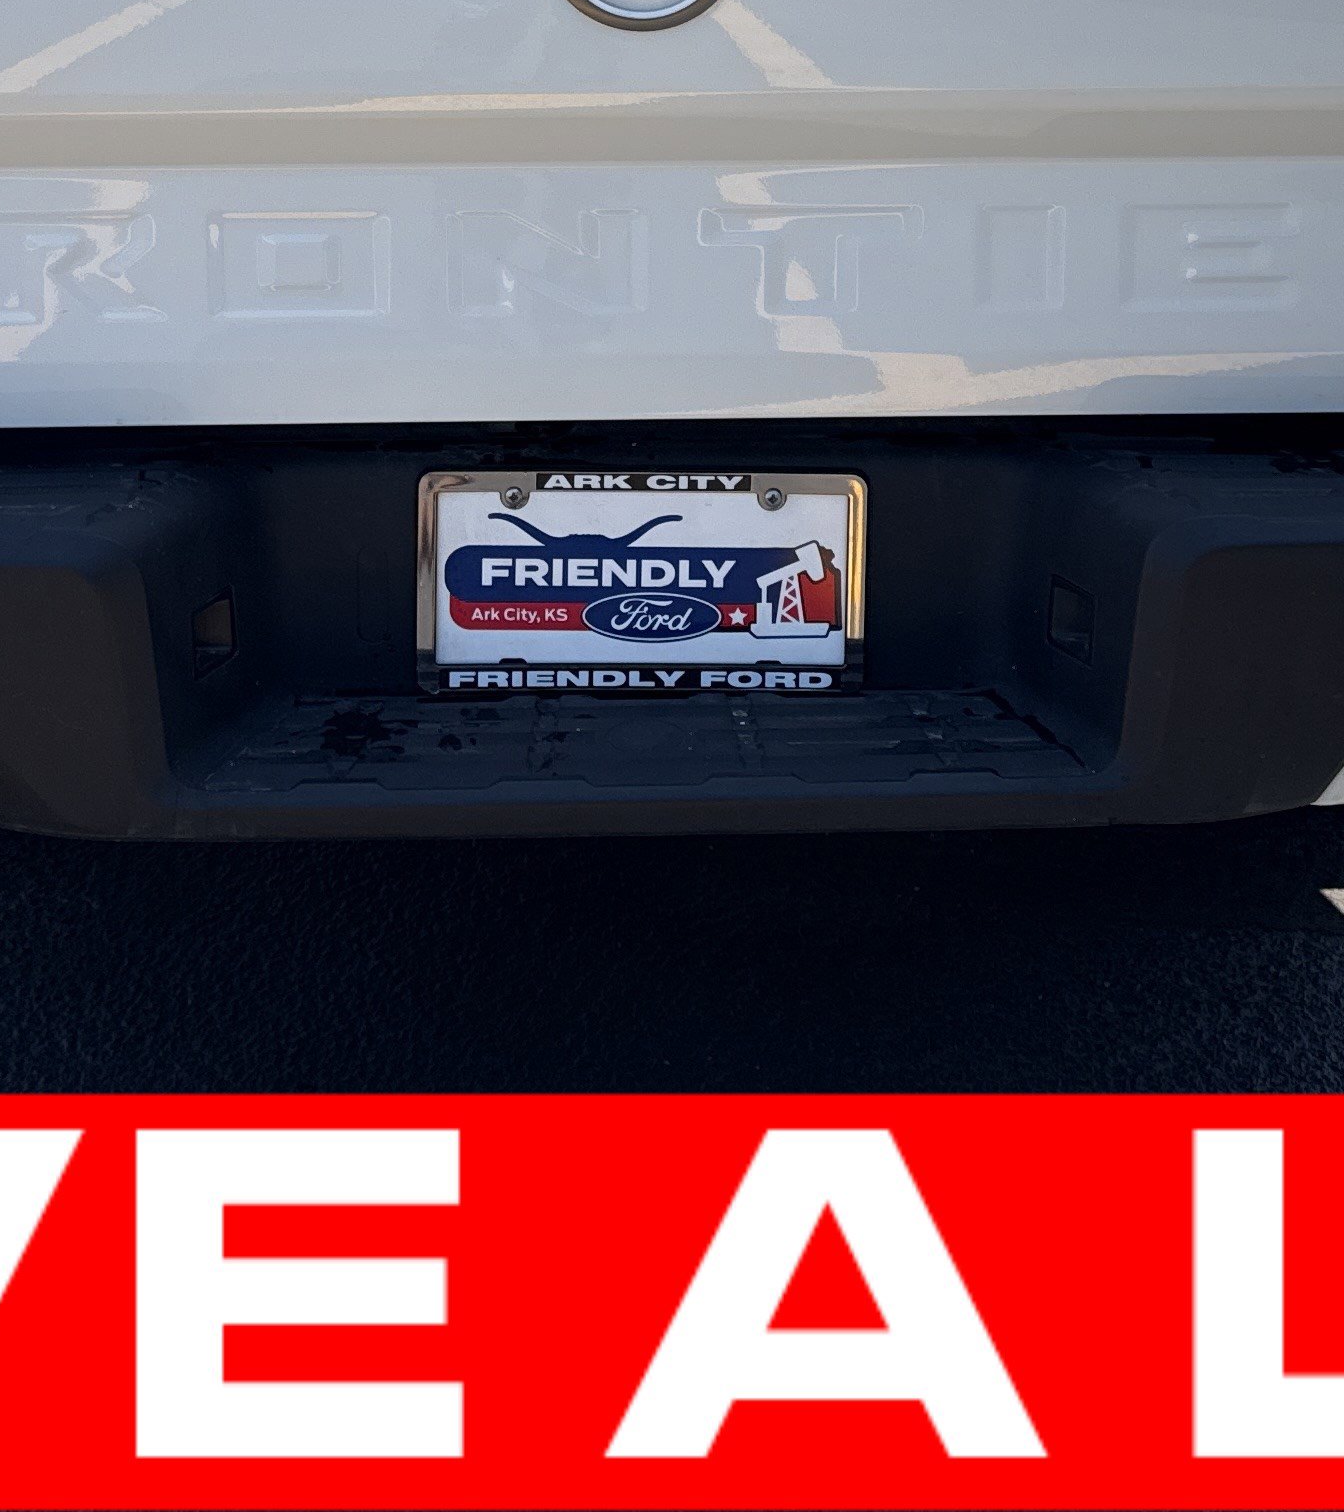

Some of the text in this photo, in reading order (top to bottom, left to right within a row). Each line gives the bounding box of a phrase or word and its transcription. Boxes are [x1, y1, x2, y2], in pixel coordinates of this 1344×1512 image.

[543, 474, 745, 491] ARK CITY
[481, 557, 737, 589] FRIENDLY
[471, 607, 568, 624] Ark City, KS
[610, 597, 693, 631] Ford
[448, 669, 834, 689] FRIENDLY FORD
